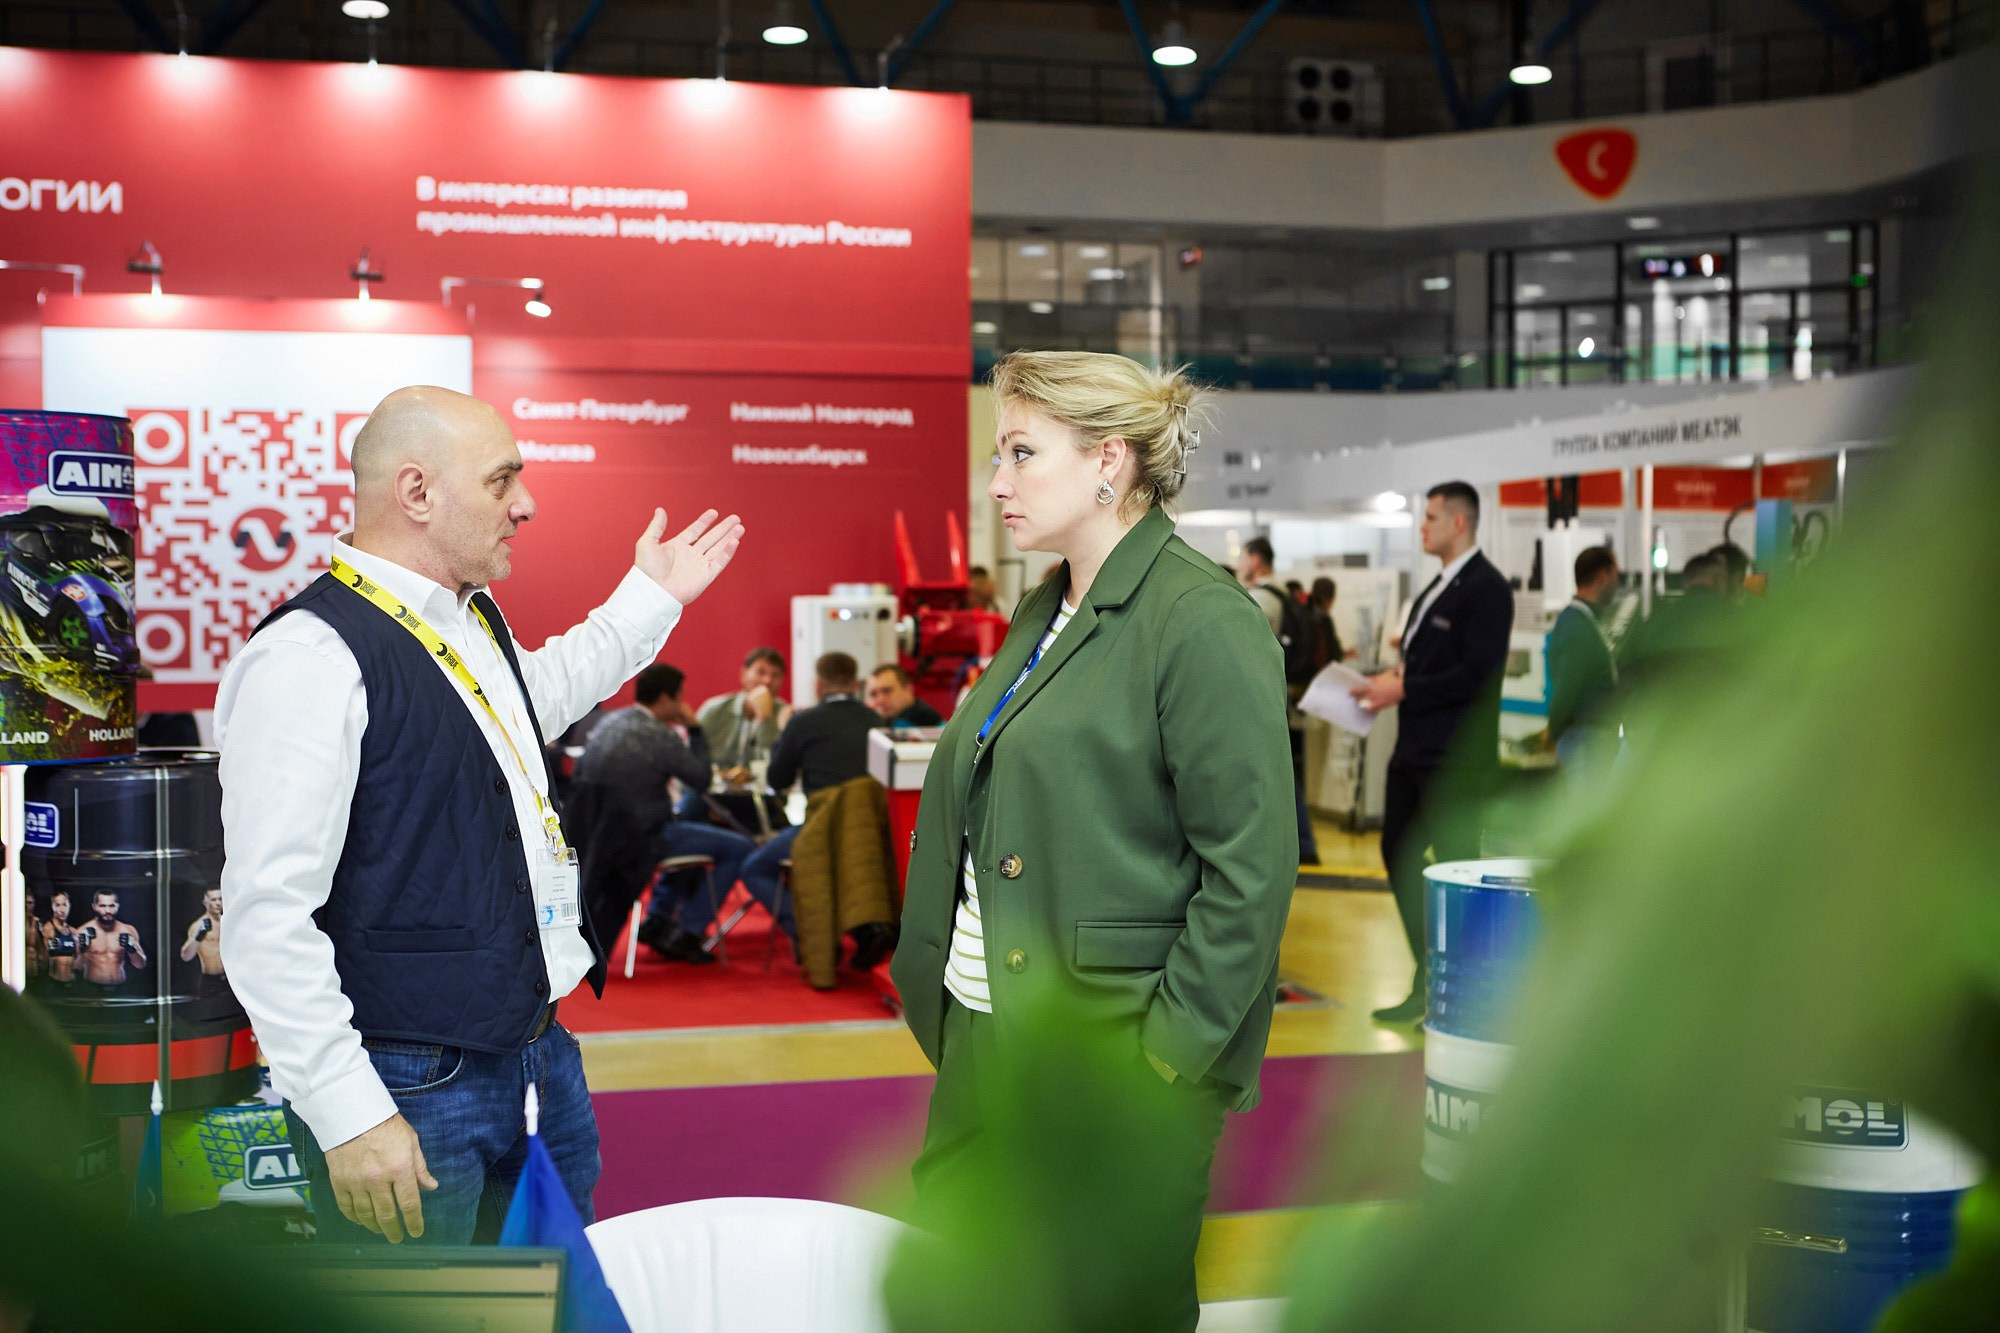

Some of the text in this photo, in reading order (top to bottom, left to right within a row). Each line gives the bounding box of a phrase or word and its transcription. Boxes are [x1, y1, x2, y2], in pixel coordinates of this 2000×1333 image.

[0, 177, 123, 215] ОГИИ
[416, 175, 688, 211] В интересах развития
[416, 211, 912, 248] промышленной инфраструктуры России
[512, 397, 690, 425] Санкт-Петербург
[730, 402, 915, 427] Нижний Новгород
[517, 440, 596, 462] Москва
[732, 444, 868, 469] Новосибирск
